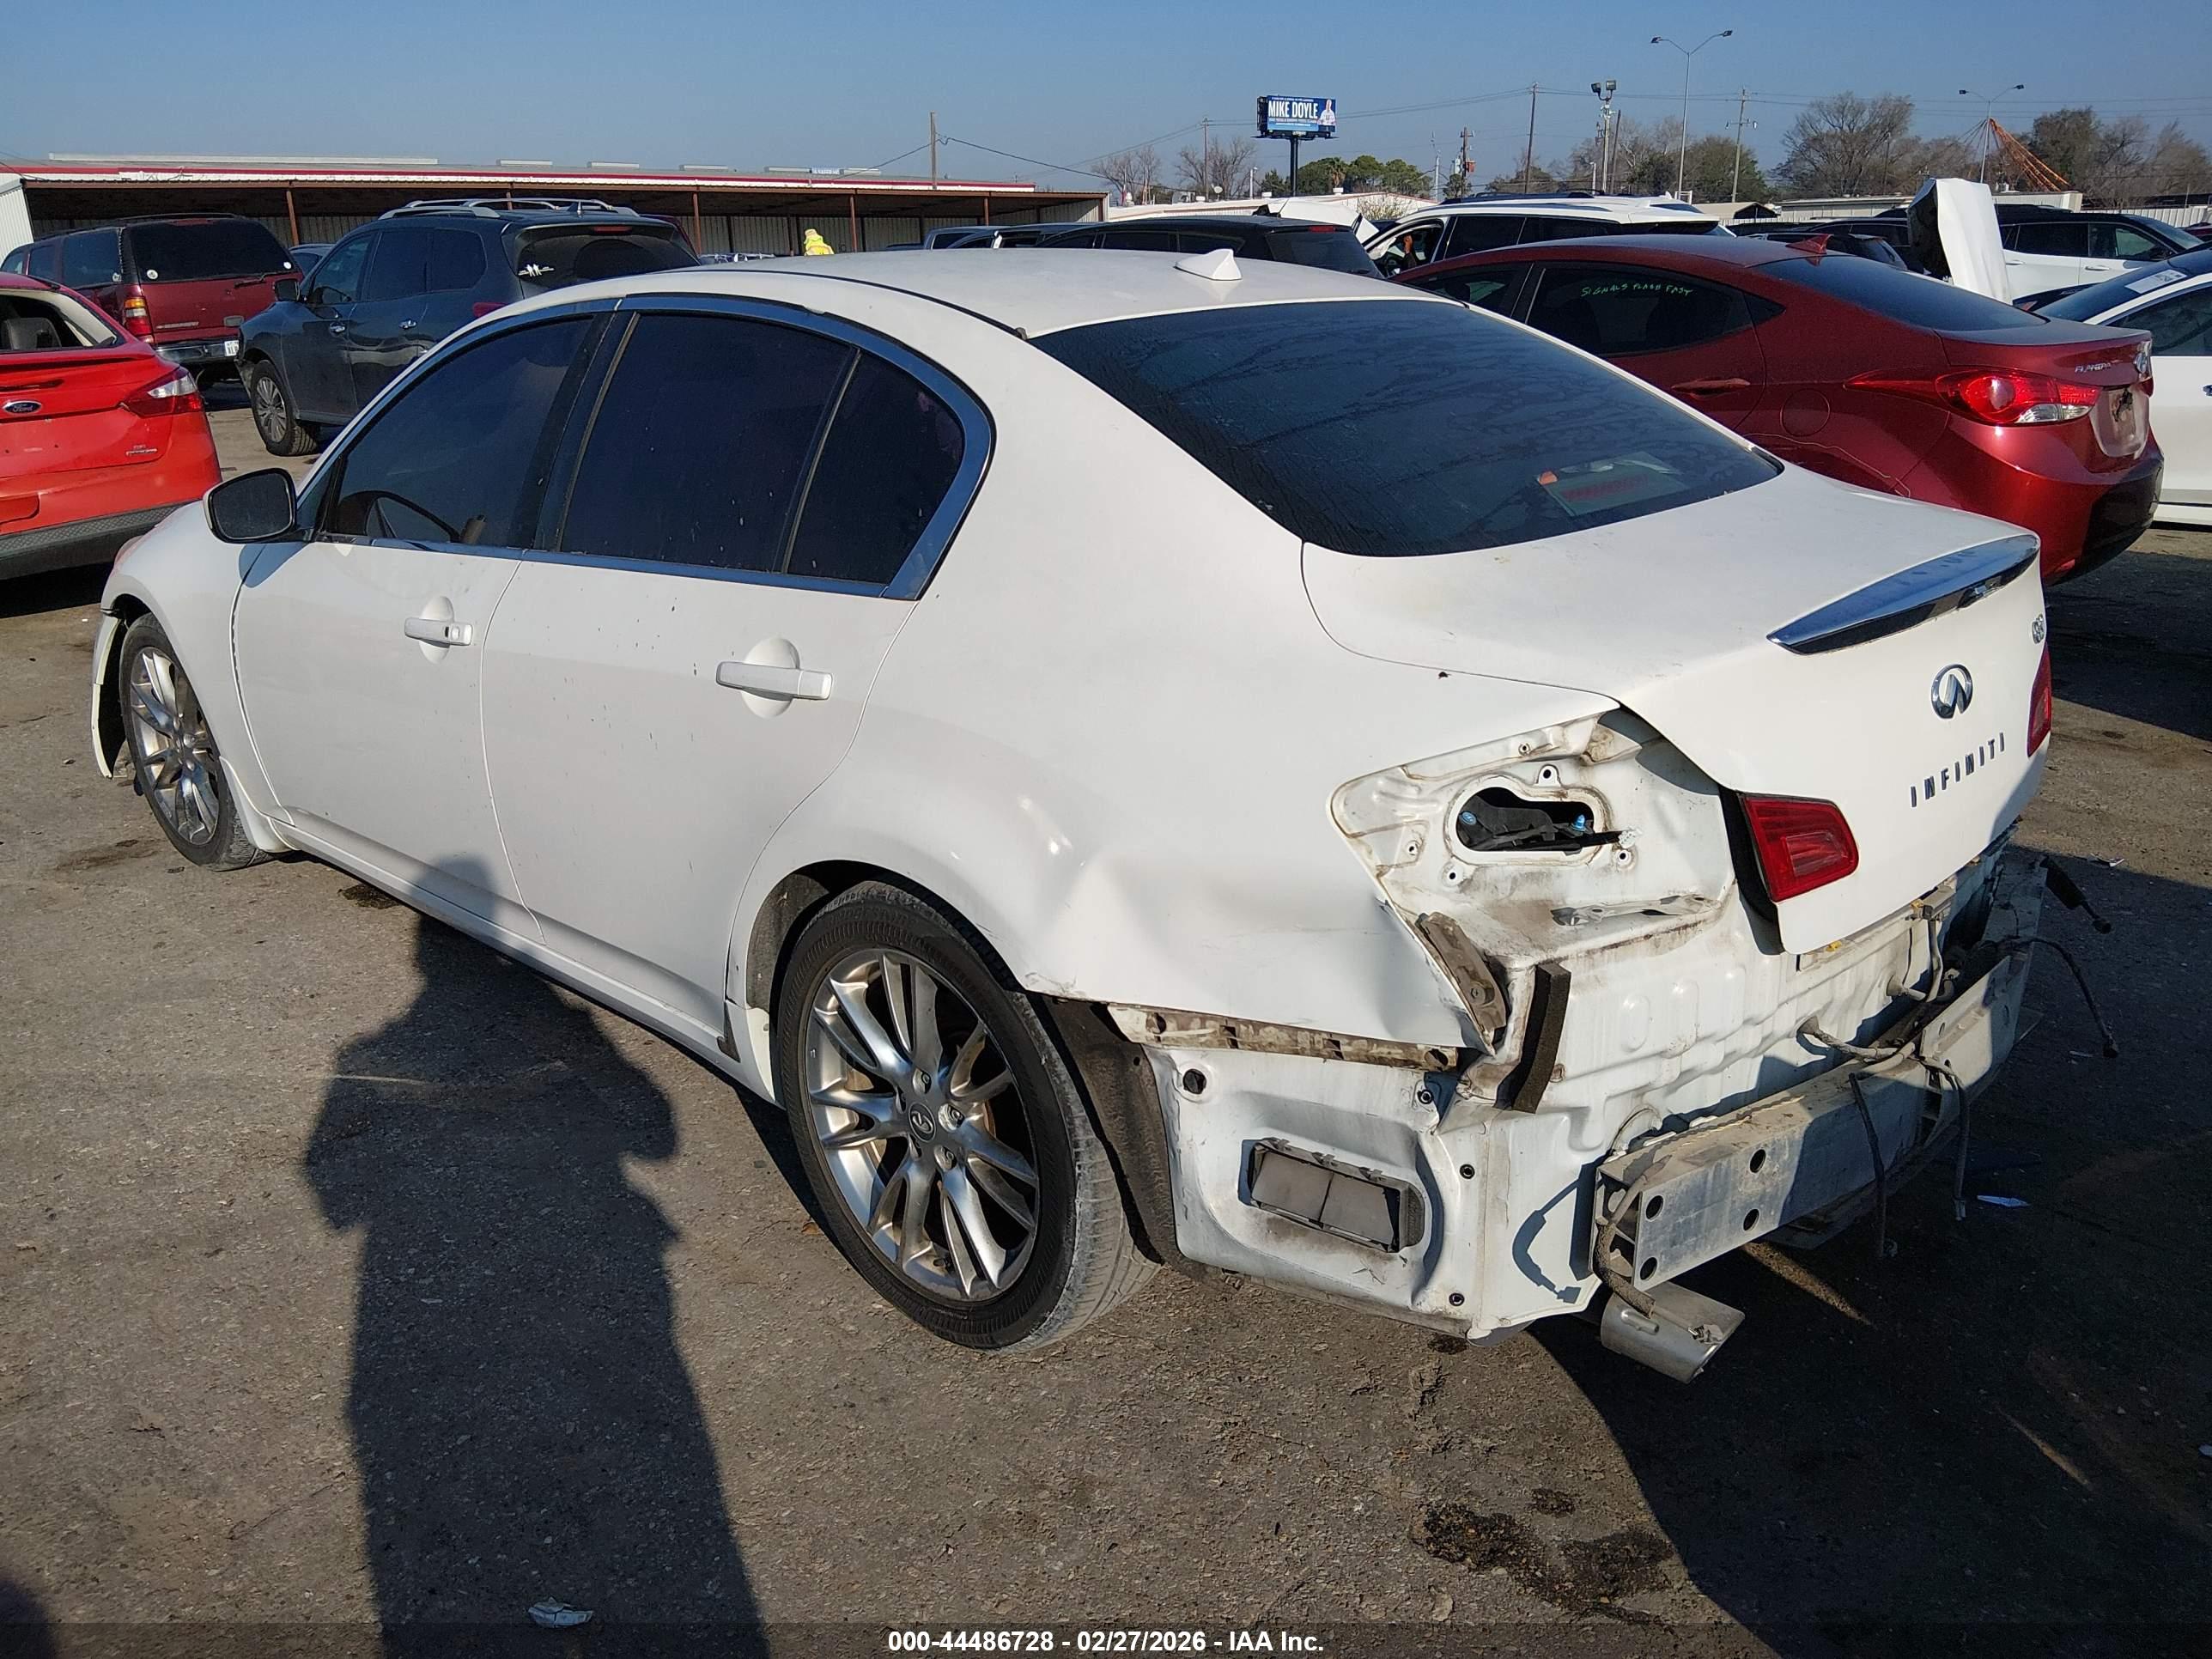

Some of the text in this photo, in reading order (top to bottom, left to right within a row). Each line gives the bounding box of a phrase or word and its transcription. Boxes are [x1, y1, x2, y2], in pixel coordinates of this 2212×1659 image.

[1268, 100, 1318, 119] MIKE DOYLE
[1580, 283, 1628, 296] SIGNALS
[1665, 284, 1693, 295] FAST
[1910, 732, 2005, 808] INFINITI
